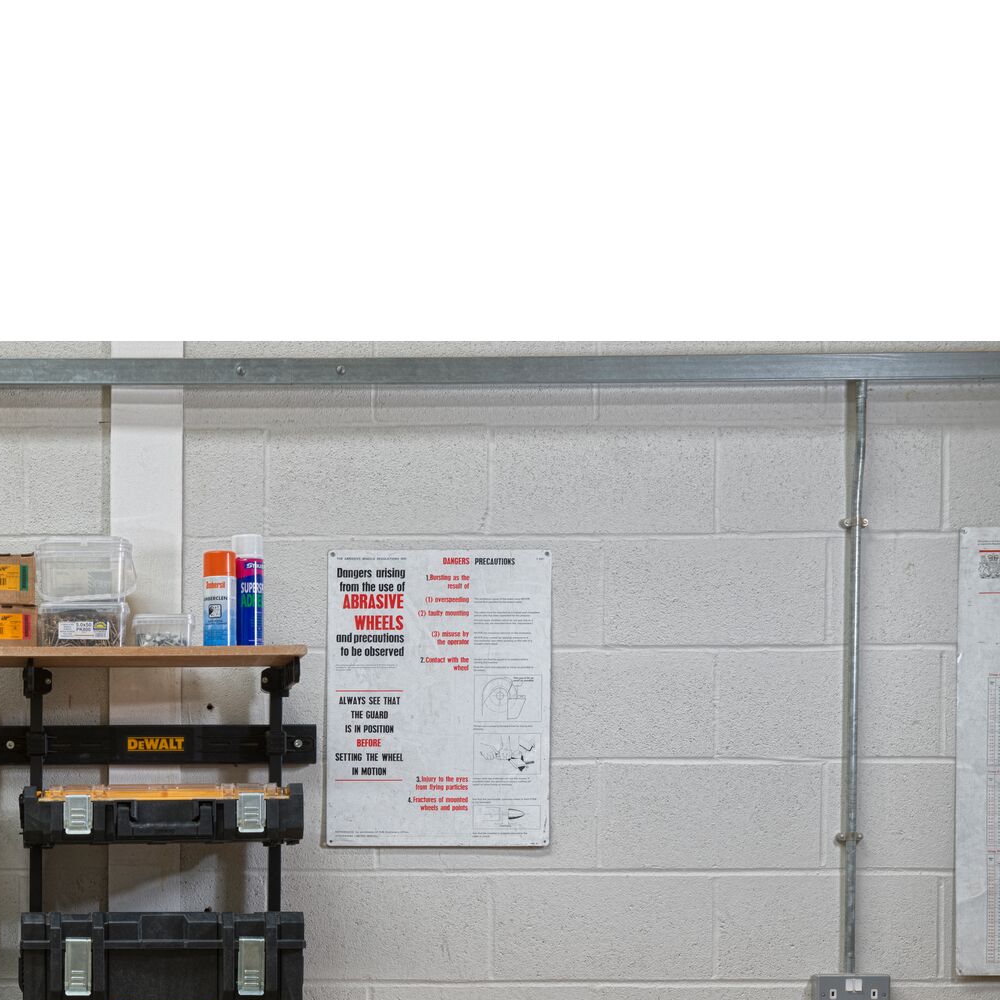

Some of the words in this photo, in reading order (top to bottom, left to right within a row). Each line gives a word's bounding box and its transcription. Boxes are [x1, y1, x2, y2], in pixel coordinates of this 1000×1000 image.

[337, 568, 372, 579] Dangers
[376, 568, 406, 579] arising
[340, 582, 359, 592] from
[362, 582, 376, 592] the
[379, 582, 394, 592] use
[397, 582, 405, 592] of
[343, 594, 404, 609] ABRASIVE
[354, 615, 404, 630] WHEELS
[336, 633, 352, 644] and
[354, 633, 405, 644] precautions
[341, 646, 349, 656] to
[352, 646, 362, 656] be
[364, 646, 405, 656] observed
[339, 696, 366, 705] ALWAYS
[369, 696, 381, 705] SEE
[384, 696, 400, 705] THAT
[351, 711, 363, 719] THE
[366, 711, 388, 719] GUARD
[345, 725, 351, 733] IS
[355, 725, 361, 733] IN
[364, 725, 394, 733] POSITION
[128, 737, 184, 750] DEWALT
[357, 739, 381, 747] BEFORE
[335, 753, 362, 761] SETTING
[366, 753, 378, 761] THE
[382, 753, 403, 761] WHEEL
[352, 767, 358, 776] IN
[361, 767, 386, 776] MOTION
